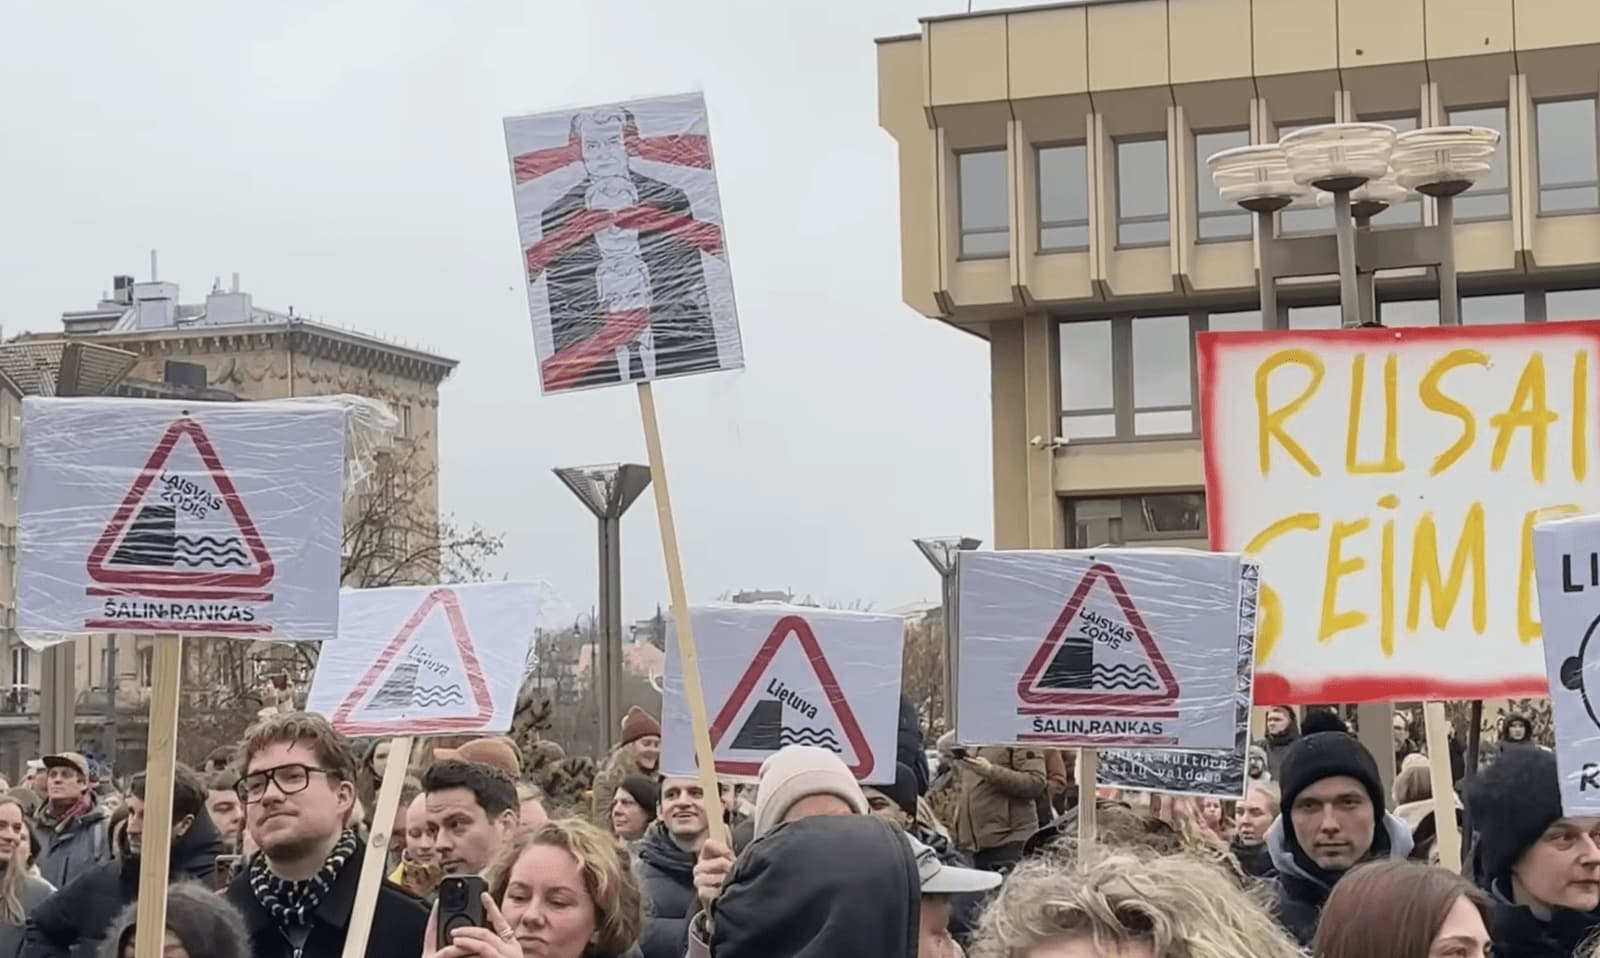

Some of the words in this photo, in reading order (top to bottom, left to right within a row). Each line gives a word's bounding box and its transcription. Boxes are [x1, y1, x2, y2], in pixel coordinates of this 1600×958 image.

[1255, 348, 1589, 484] RUSAI
[160, 469, 223, 511] LAISVAS
[1079, 607, 1134, 642] LAISVAS
[1080, 622, 1121, 650] ŽODIS
[766, 678, 818, 720] Lietuva
